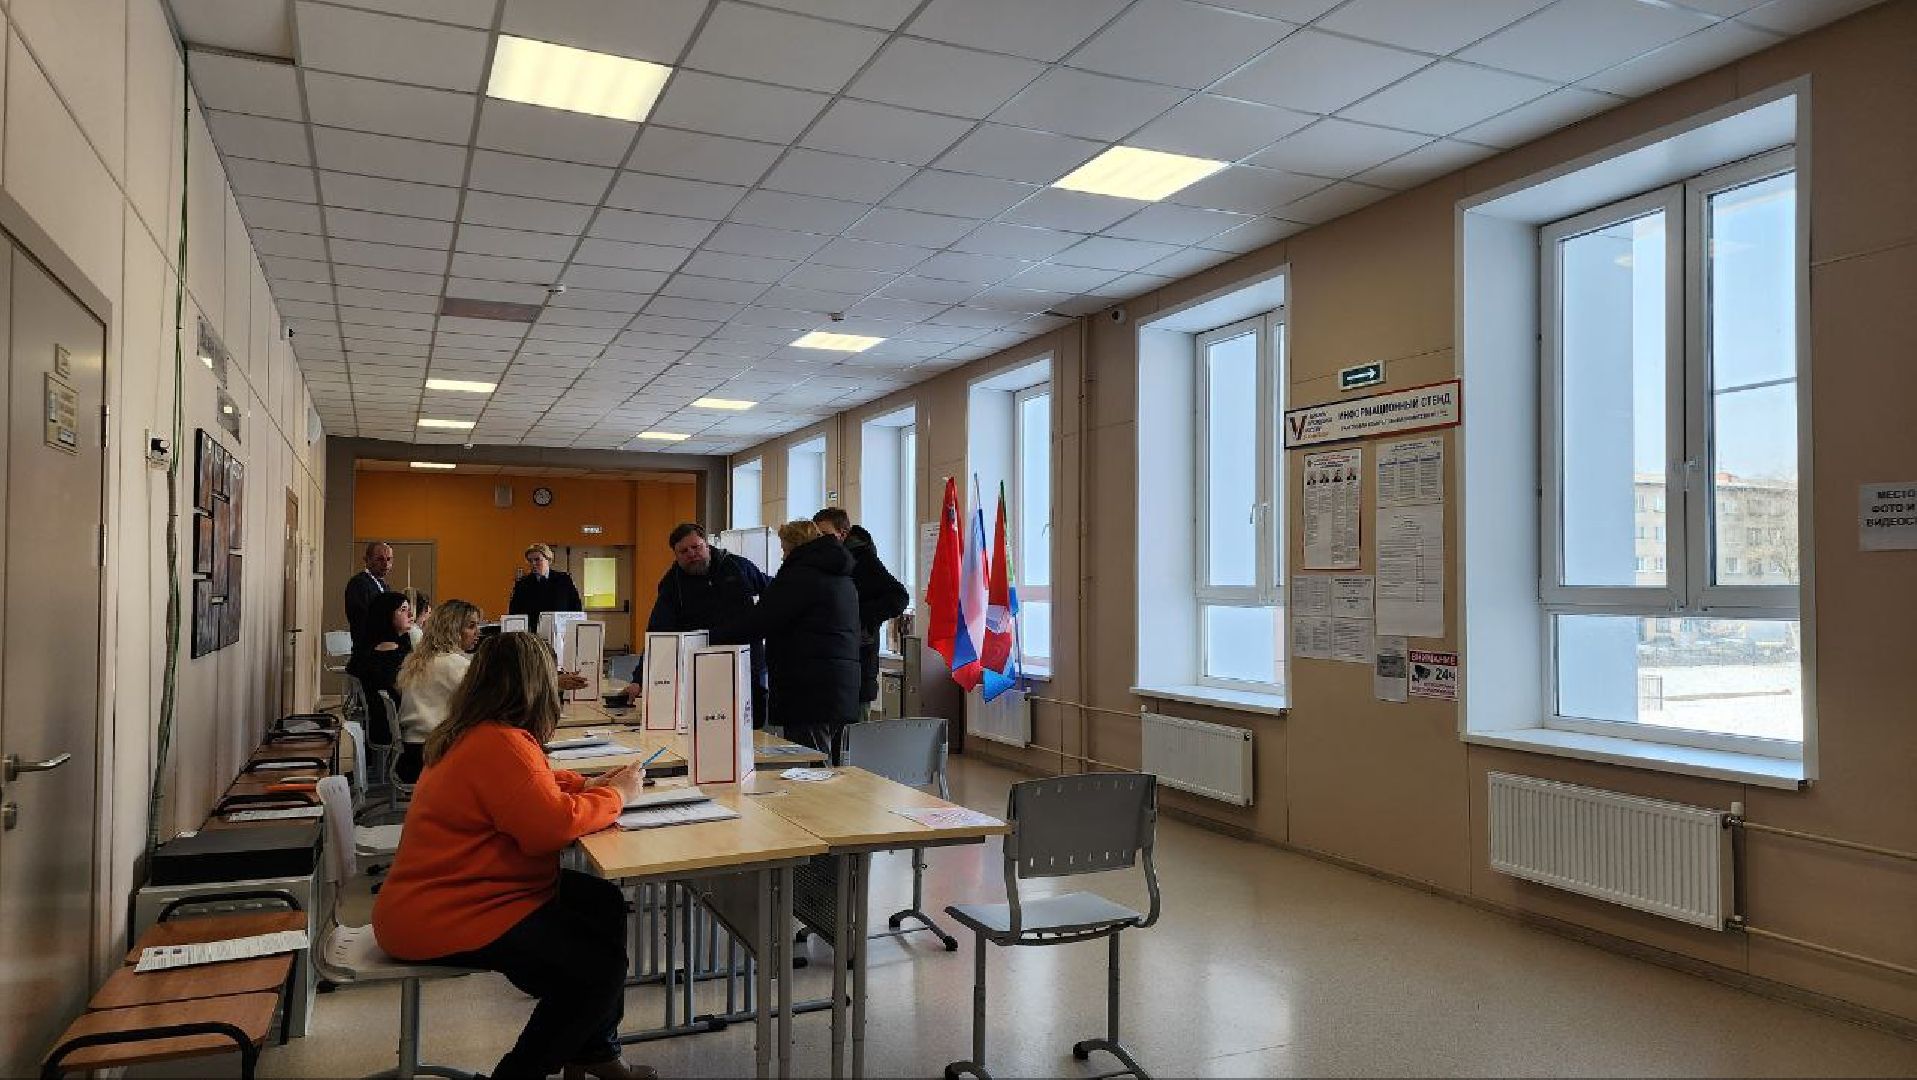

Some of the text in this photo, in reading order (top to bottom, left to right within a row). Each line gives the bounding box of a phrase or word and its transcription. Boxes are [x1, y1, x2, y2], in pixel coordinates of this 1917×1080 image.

[1421, 392, 1451, 407] СТЕНД
[1877, 489, 1915, 498] МЕСТО
[1872, 503, 1903, 512] ФОТО
[1866, 517, 1917, 527] ВИДЕОС
[1411, 653, 1456, 665] ВНИМАНИЕ
